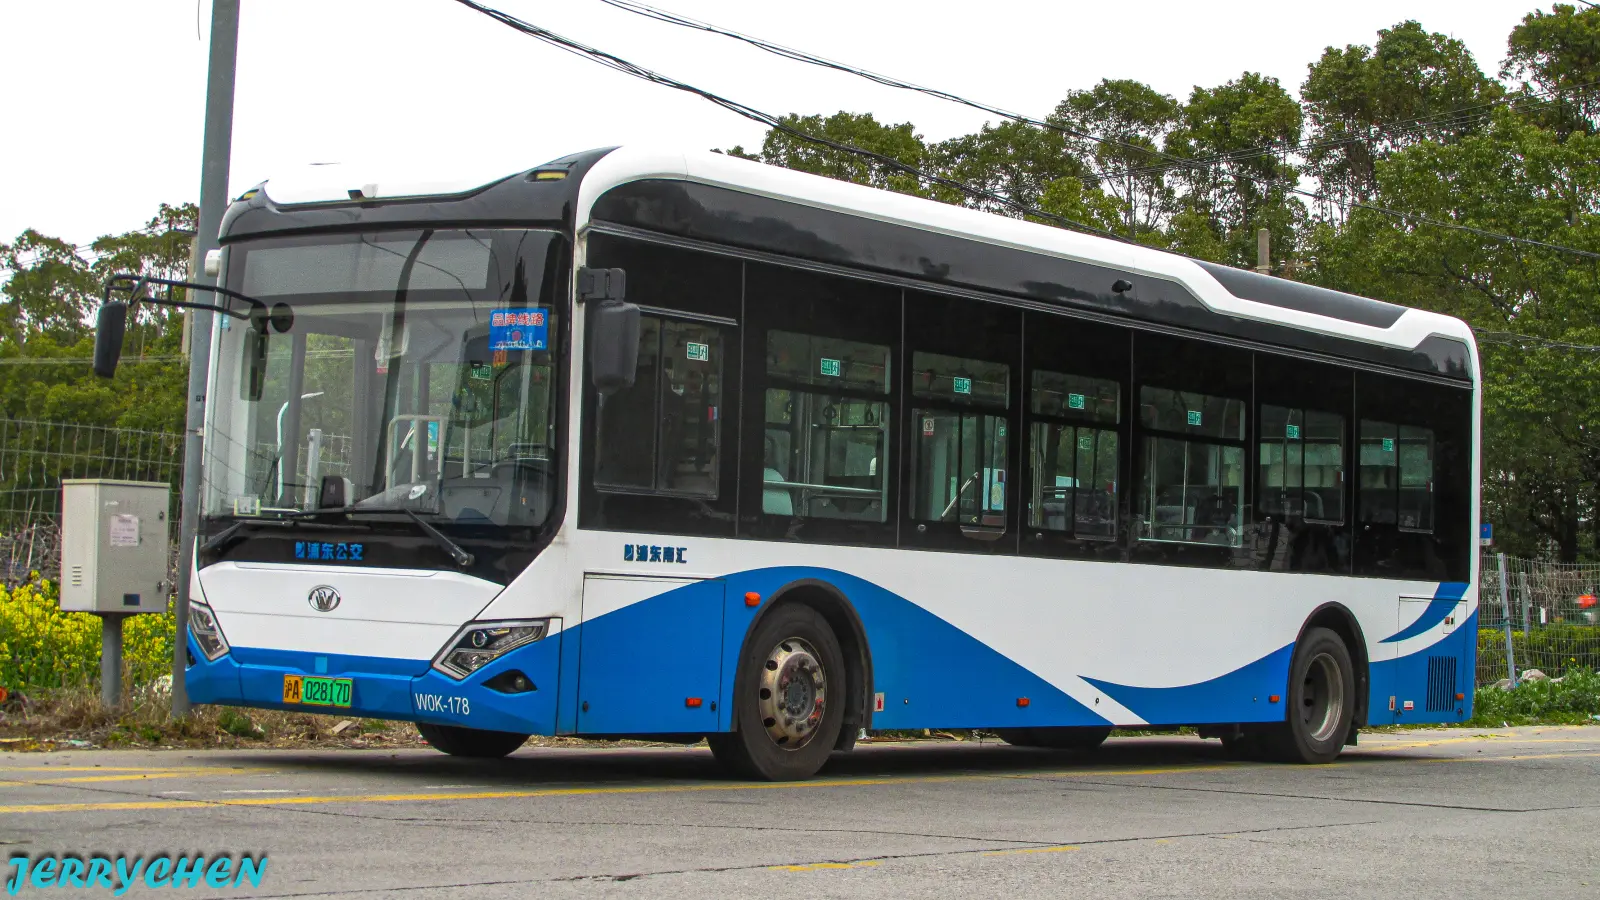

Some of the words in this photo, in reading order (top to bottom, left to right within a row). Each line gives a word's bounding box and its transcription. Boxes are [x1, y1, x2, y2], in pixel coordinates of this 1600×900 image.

[492, 313, 544, 326] 品牌线路
[307, 542, 363, 560] 浦东公交
[636, 544, 688, 563] 浦东南汇
[305, 681, 350, 703] 02817D
